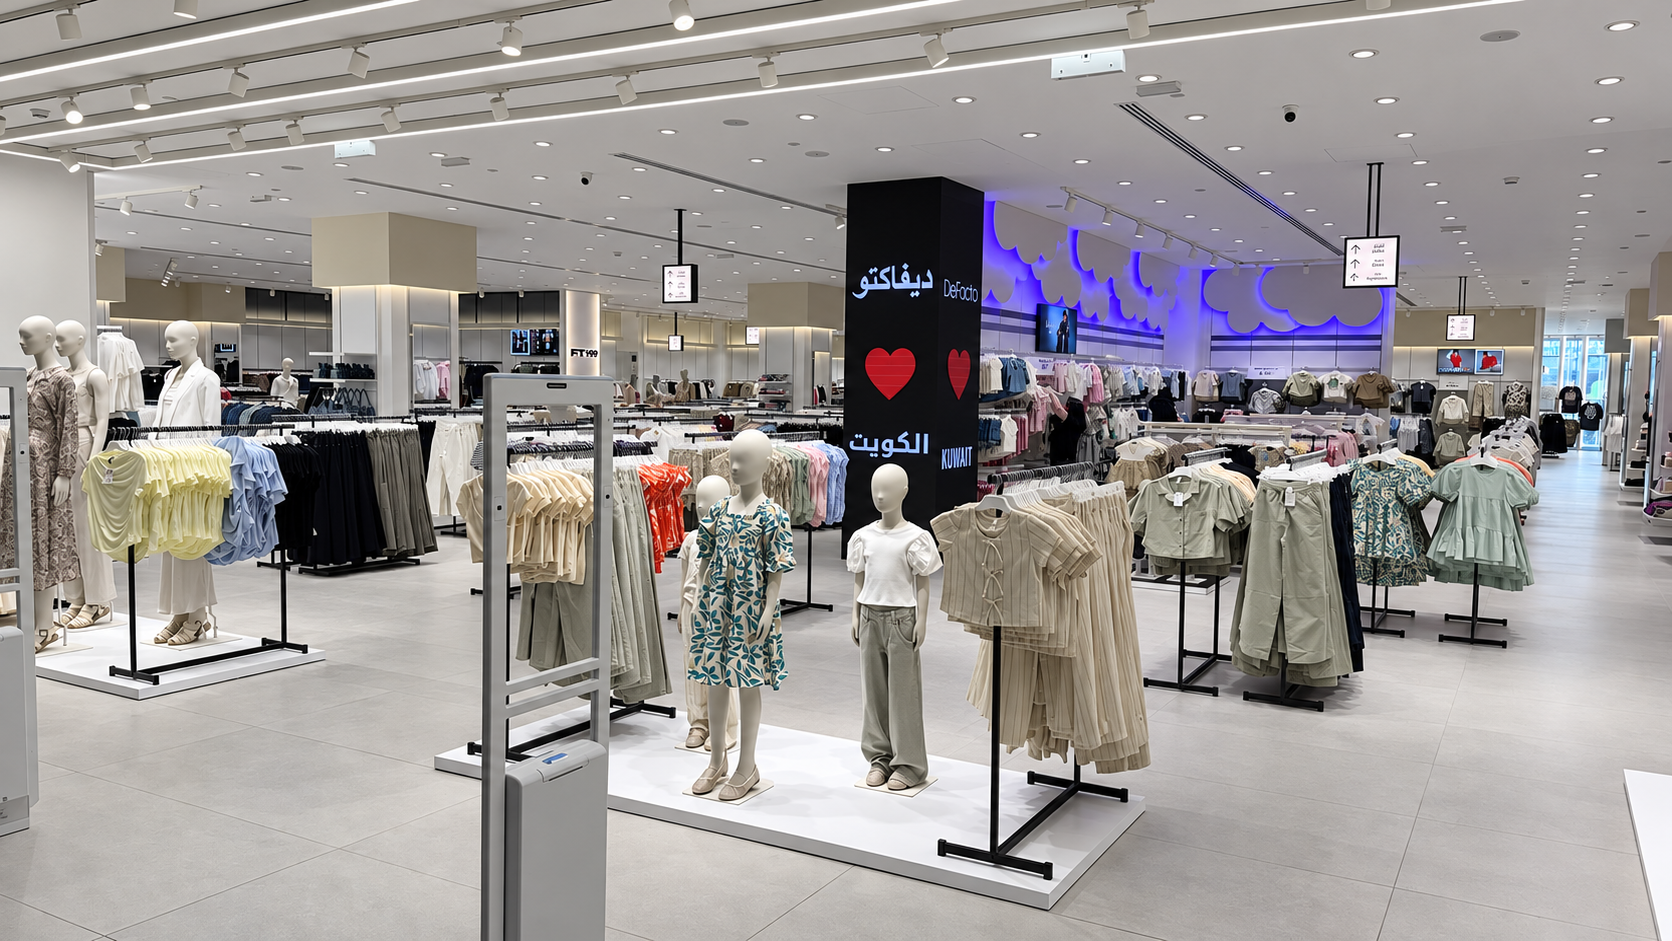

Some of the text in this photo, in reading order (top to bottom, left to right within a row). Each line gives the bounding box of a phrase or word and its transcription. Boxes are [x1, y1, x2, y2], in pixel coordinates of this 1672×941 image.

[852, 262, 934, 299] ديفاكتو
[943, 278, 979, 303] DeFacto
[849, 431, 929, 458] الكويت
[941, 446, 973, 470] KUWAIT
